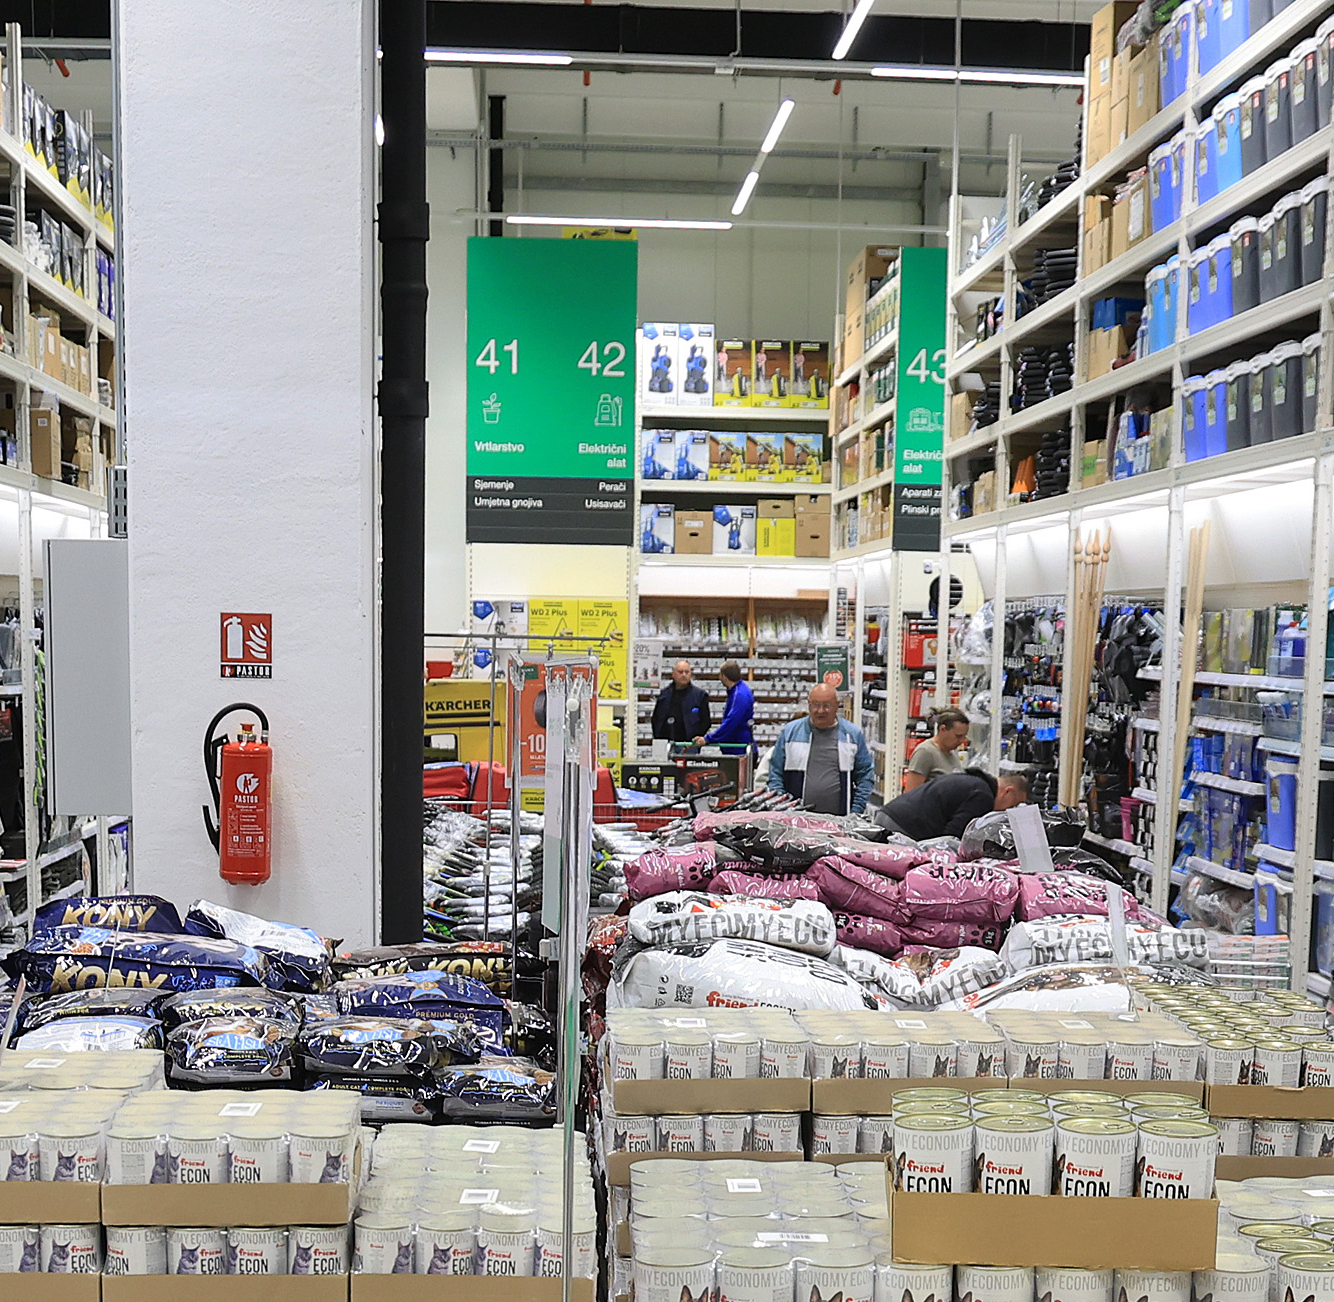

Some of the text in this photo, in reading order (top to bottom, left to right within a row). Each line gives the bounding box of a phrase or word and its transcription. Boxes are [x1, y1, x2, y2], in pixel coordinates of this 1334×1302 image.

[475, 338, 518, 375] 41
[577, 340, 626, 377] 42
[905, 348, 947, 384] 43
[474, 440, 525, 453] Vrtlarstvo
[578, 442, 627, 454] Električni
[902, 449, 943, 460] Električ
[607, 457, 627, 468] alat
[902, 463, 923, 473] alat
[474, 479, 514, 490] Sjemenje
[901, 487, 932, 498] Aparati
[474, 497, 543, 508] Umjetna gnojiva
[901, 504, 929, 515] Plinski
[602, 609, 617, 617] Plus
[237, 666, 270, 676] PASTOR
[425, 699, 491, 711] KÄRCHER
[521, 734, 546, 752] -10
[61, 904, 157, 931] KONY
[906, 1160, 944, 1174] friend
[1066, 1162, 1104, 1178] friend
[1146, 1165, 1183, 1181] friend
